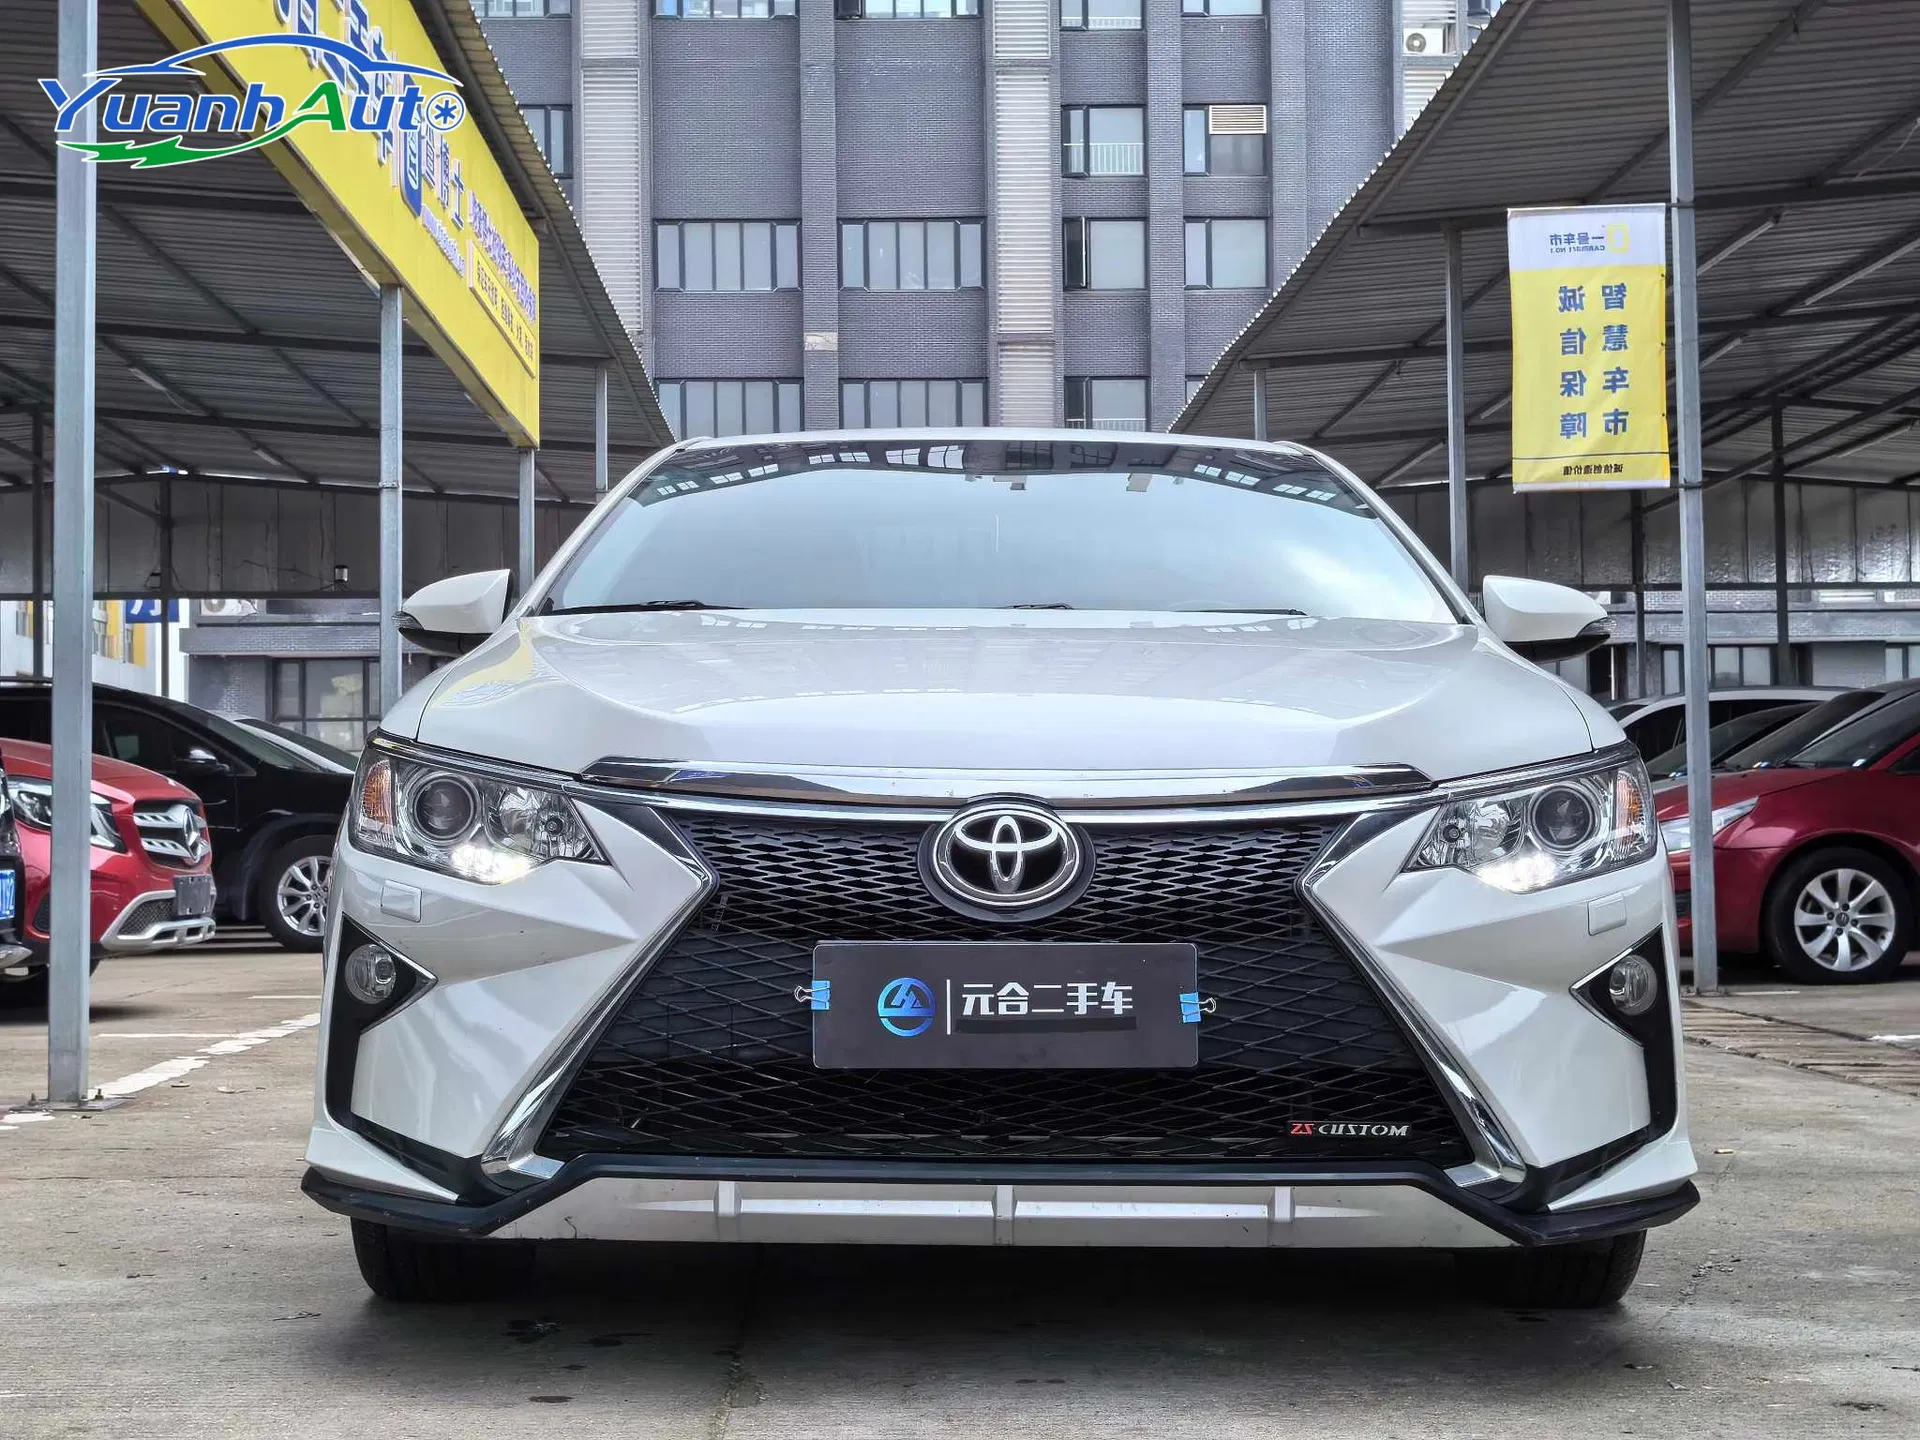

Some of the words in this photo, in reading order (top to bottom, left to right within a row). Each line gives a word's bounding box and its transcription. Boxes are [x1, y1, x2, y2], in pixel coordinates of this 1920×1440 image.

[961, 981, 1134, 1016] 元合二手车
[1318, 1124, 1410, 1137] CUSTOM
